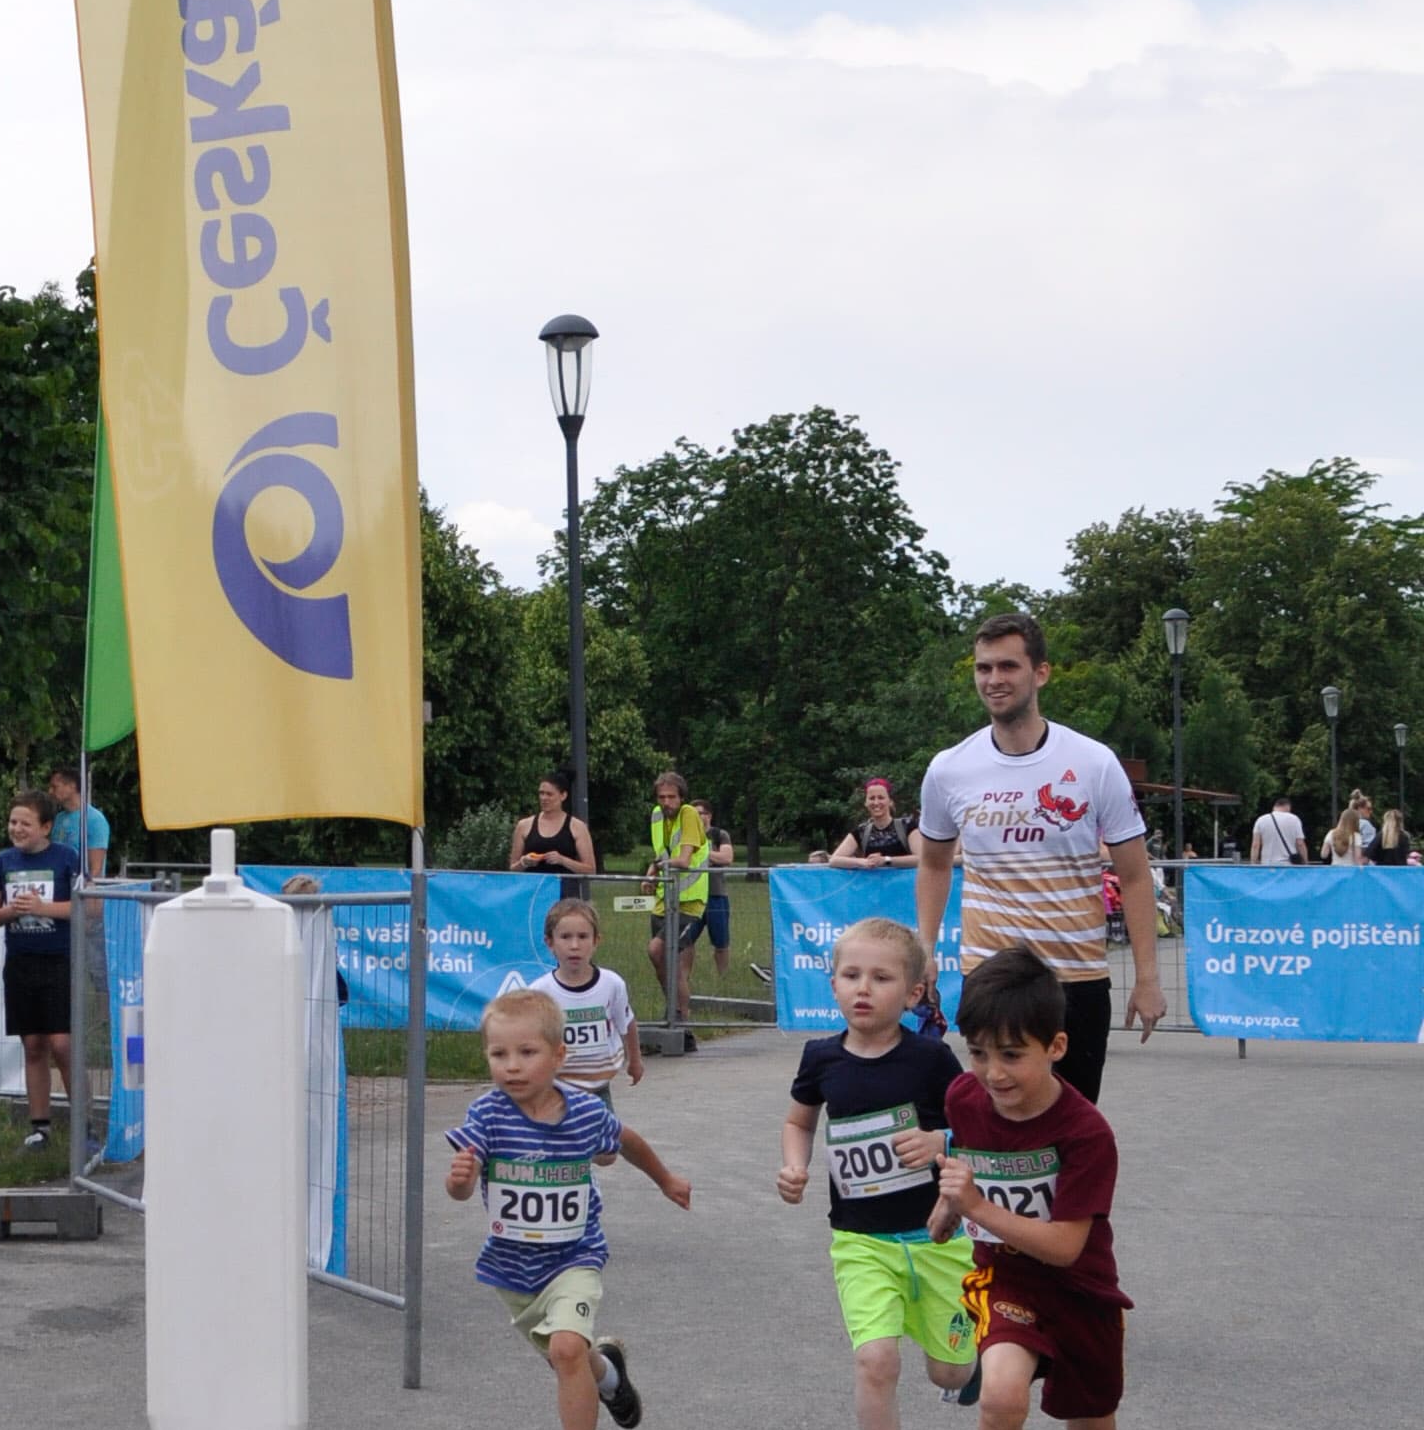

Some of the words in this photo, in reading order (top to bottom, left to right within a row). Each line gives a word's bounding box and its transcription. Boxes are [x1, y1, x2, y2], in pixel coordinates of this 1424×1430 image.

[983, 791, 1024, 803] PVZP
[962, 804, 1031, 828] Fénix
[1002, 826, 1045, 844] run
[366, 923, 410, 943] vaši
[426, 924, 494, 949] odinu,
[1206, 918, 1305, 945] Úrazové
[1312, 923, 1421, 950] pojištění
[366, 951, 474, 973] podkání
[1205, 953, 1236, 975] od
[1244, 955, 1312, 976] PVZP
[1205, 1012, 1301, 1029] www.pvzp.cz
[563, 1025, 599, 1045] 051
[834, 1142, 905, 1180] 200
[1002, 1152, 1056, 1176] HELP
[500, 1189, 580, 1223] 2016
